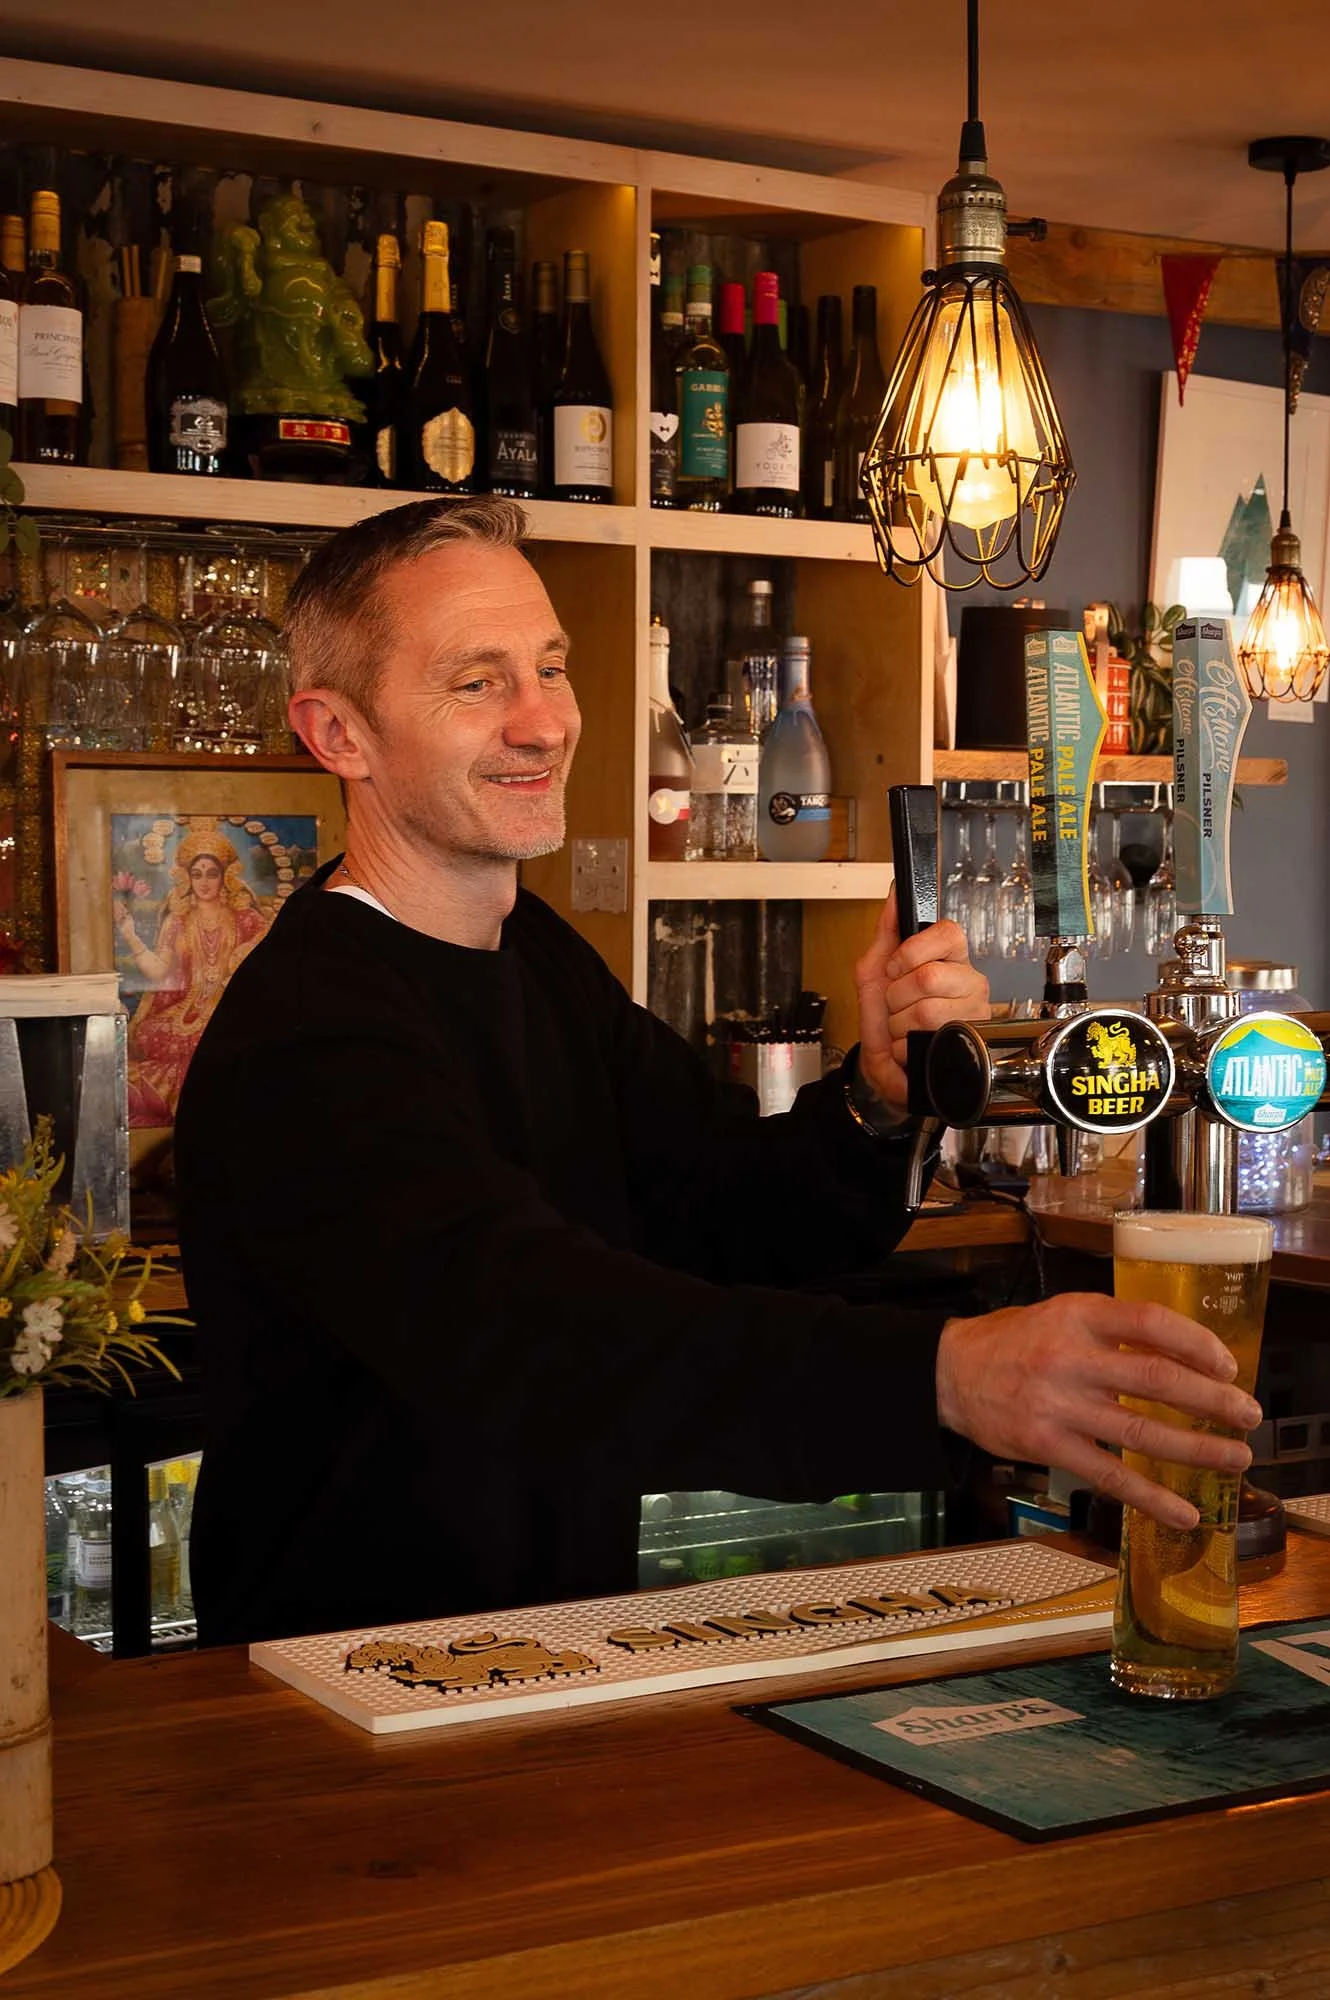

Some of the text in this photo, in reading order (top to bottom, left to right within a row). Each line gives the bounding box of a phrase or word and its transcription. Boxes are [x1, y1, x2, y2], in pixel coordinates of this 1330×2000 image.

[496, 440, 538, 461] AYALA
[1027, 666, 1049, 743] ATLANTIC
[1052, 663, 1082, 742] ATLANTIC
[1055, 745, 1077, 797] PALE
[1175, 738, 1186, 803] PILSNER
[1200, 658, 1241, 839] Offshore PILSNER
[1029, 747, 1046, 798] PALE
[1031, 805, 1048, 841] ALE
[1058, 804, 1078, 841] ALE
[1071, 1071, 1160, 1097] SINGHA
[1221, 1054, 1303, 1097] ATLANTIC
[1087, 1096, 1145, 1115] BEER
[607, 1584, 1004, 1654] SINGHA
[896, 1702, 1051, 1734] Sharp's
